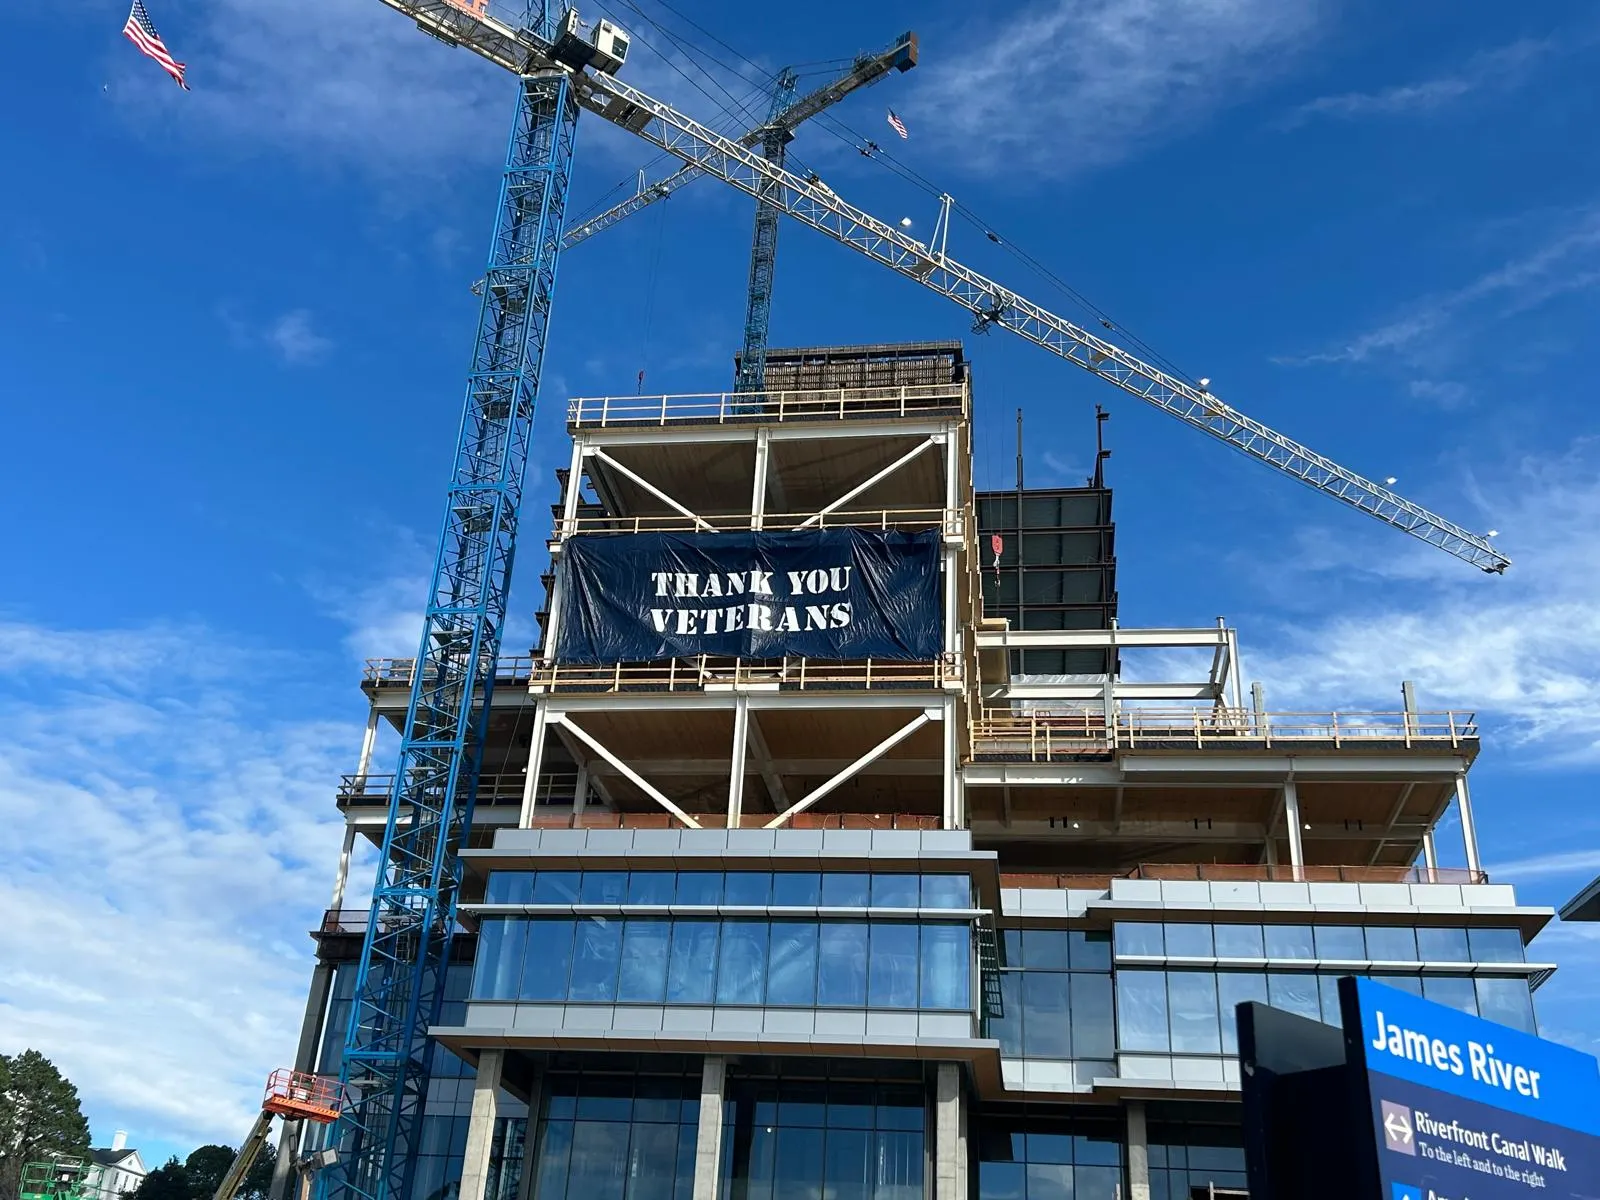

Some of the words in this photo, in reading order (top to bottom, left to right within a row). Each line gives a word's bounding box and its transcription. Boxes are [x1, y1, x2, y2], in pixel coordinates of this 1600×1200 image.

[651, 570, 773, 597] THANK
[787, 566, 852, 596] YOU
[650, 602, 851, 635] VETERANS
[1372, 1010, 1464, 1076] James
[1467, 1040, 1541, 1100] River
[1414, 1110, 1490, 1151] Riverfront
[1491, 1133, 1530, 1162] Canal
[1531, 1144, 1567, 1172] Walk
[1418, 1141, 1435, 1159] To
[1435, 1146, 1452, 1164] the
[1453, 1150, 1472, 1169] left
[1473, 1159, 1491, 1175] and
[1492, 1164, 1503, 1177] to
[1504, 1164, 1520, 1182] the
[1521, 1169, 1546, 1188] right
